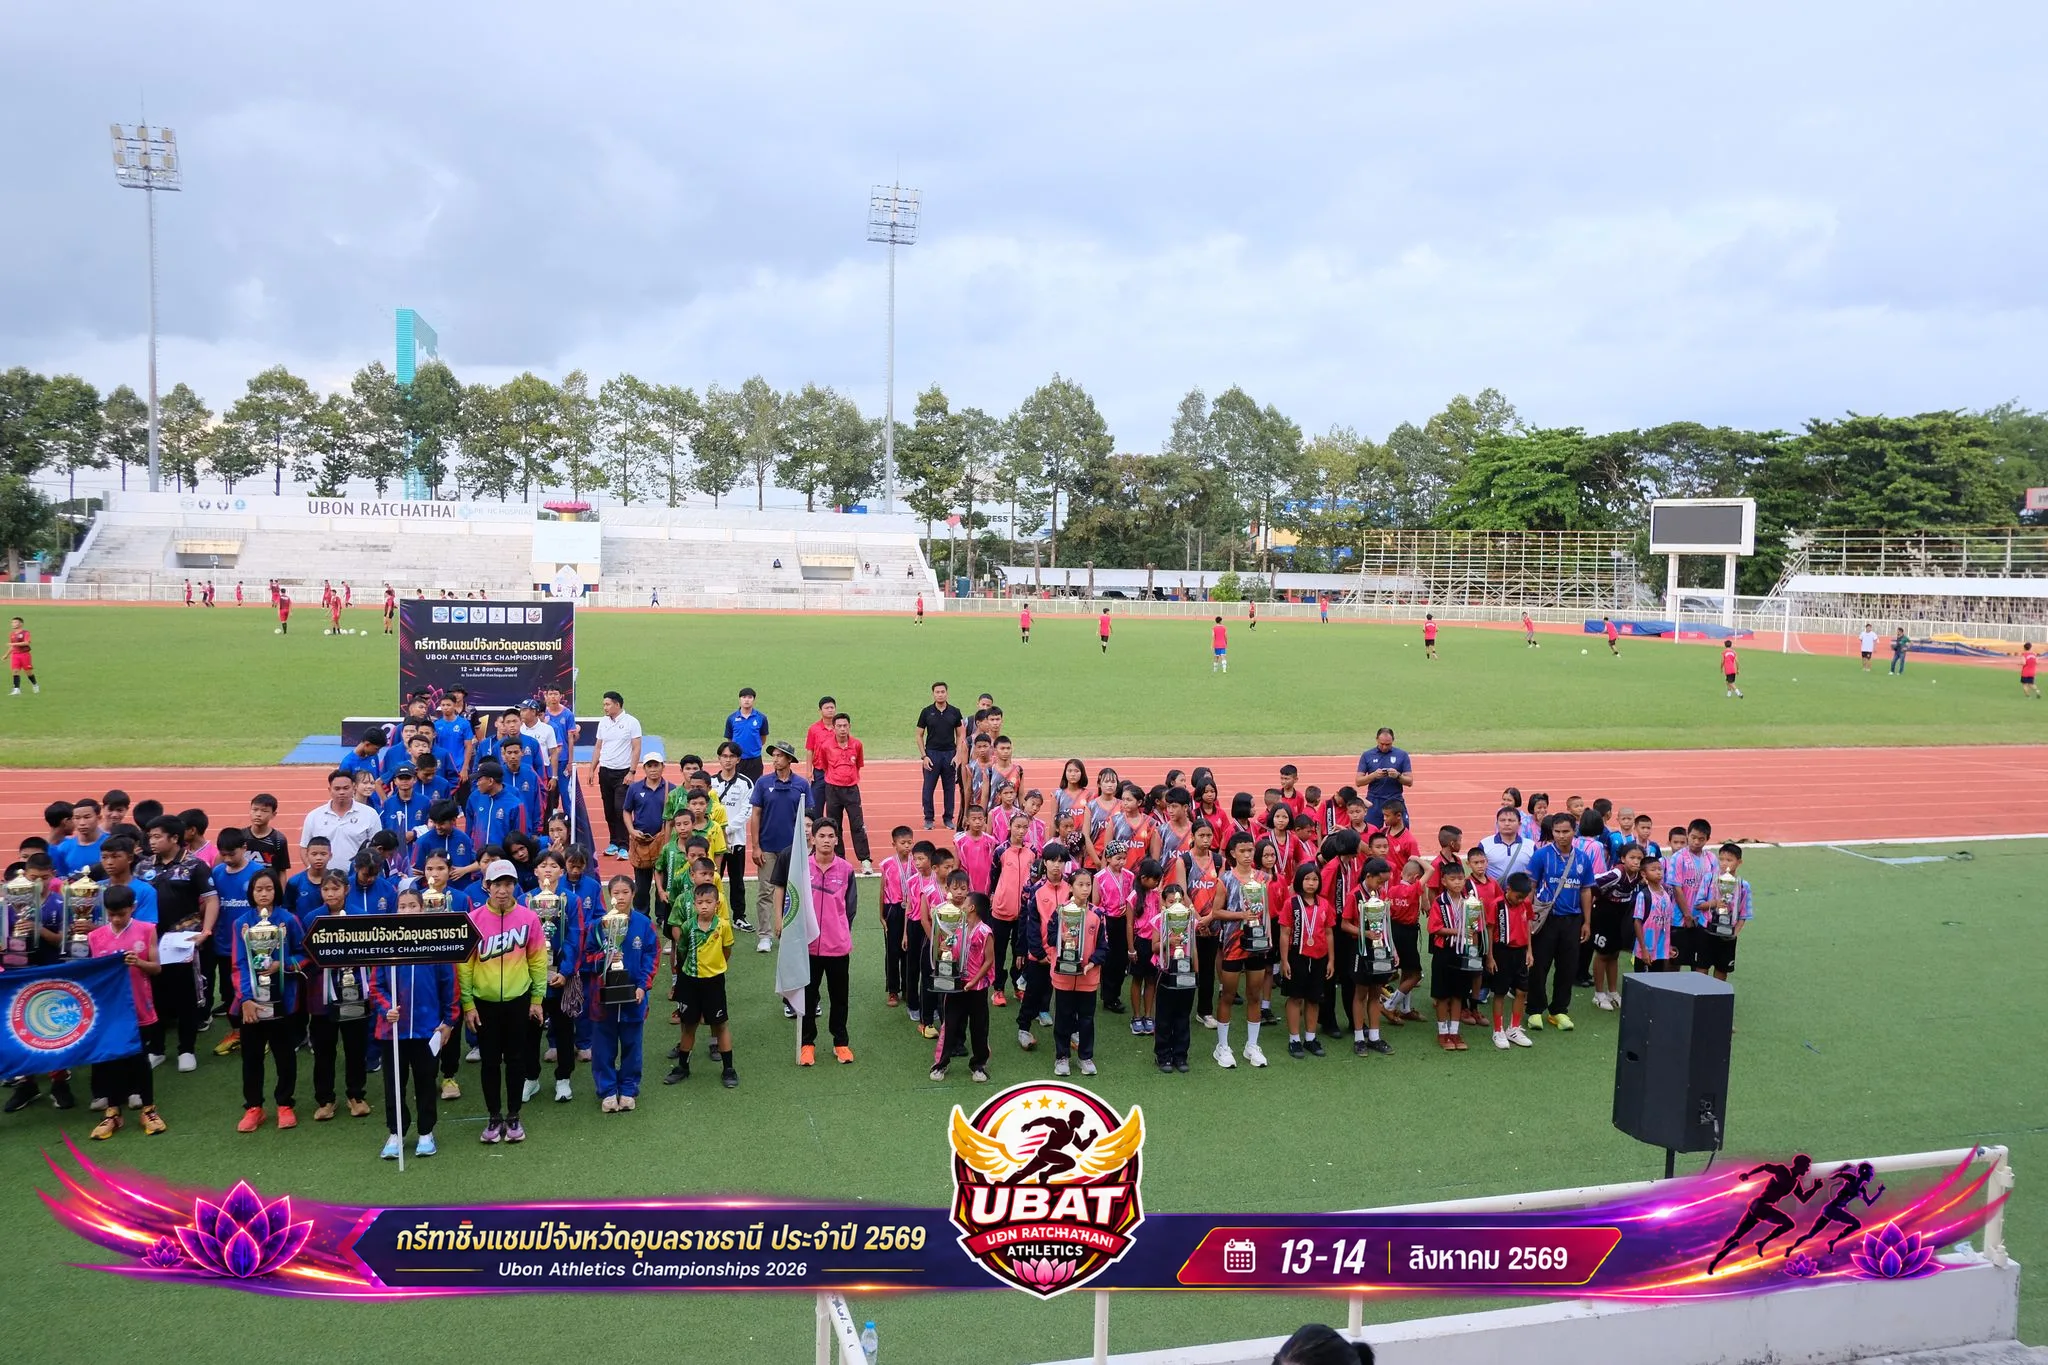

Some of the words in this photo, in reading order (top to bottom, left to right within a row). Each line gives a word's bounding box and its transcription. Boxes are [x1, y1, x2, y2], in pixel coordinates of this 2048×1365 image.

[308, 502, 354, 516] UBON
[985, 515, 1009, 523] RESS
[425, 653, 448, 661] UBON
[450, 653, 492, 661] ATHLETICS
[494, 653, 554, 662] CHAMPIONSHIPS
[1098, 821, 1111, 830] KN
[1122, 840, 1145, 849] KNP
[1192, 880, 1215, 890] KNP
[477, 924, 530, 962] UBN
[1593, 933, 1608, 949] 16
[318, 949, 345, 957] UBON
[347, 946, 396, 955] ATHLETICS
[397, 943, 465, 954] CHAMPIONSHIPS
